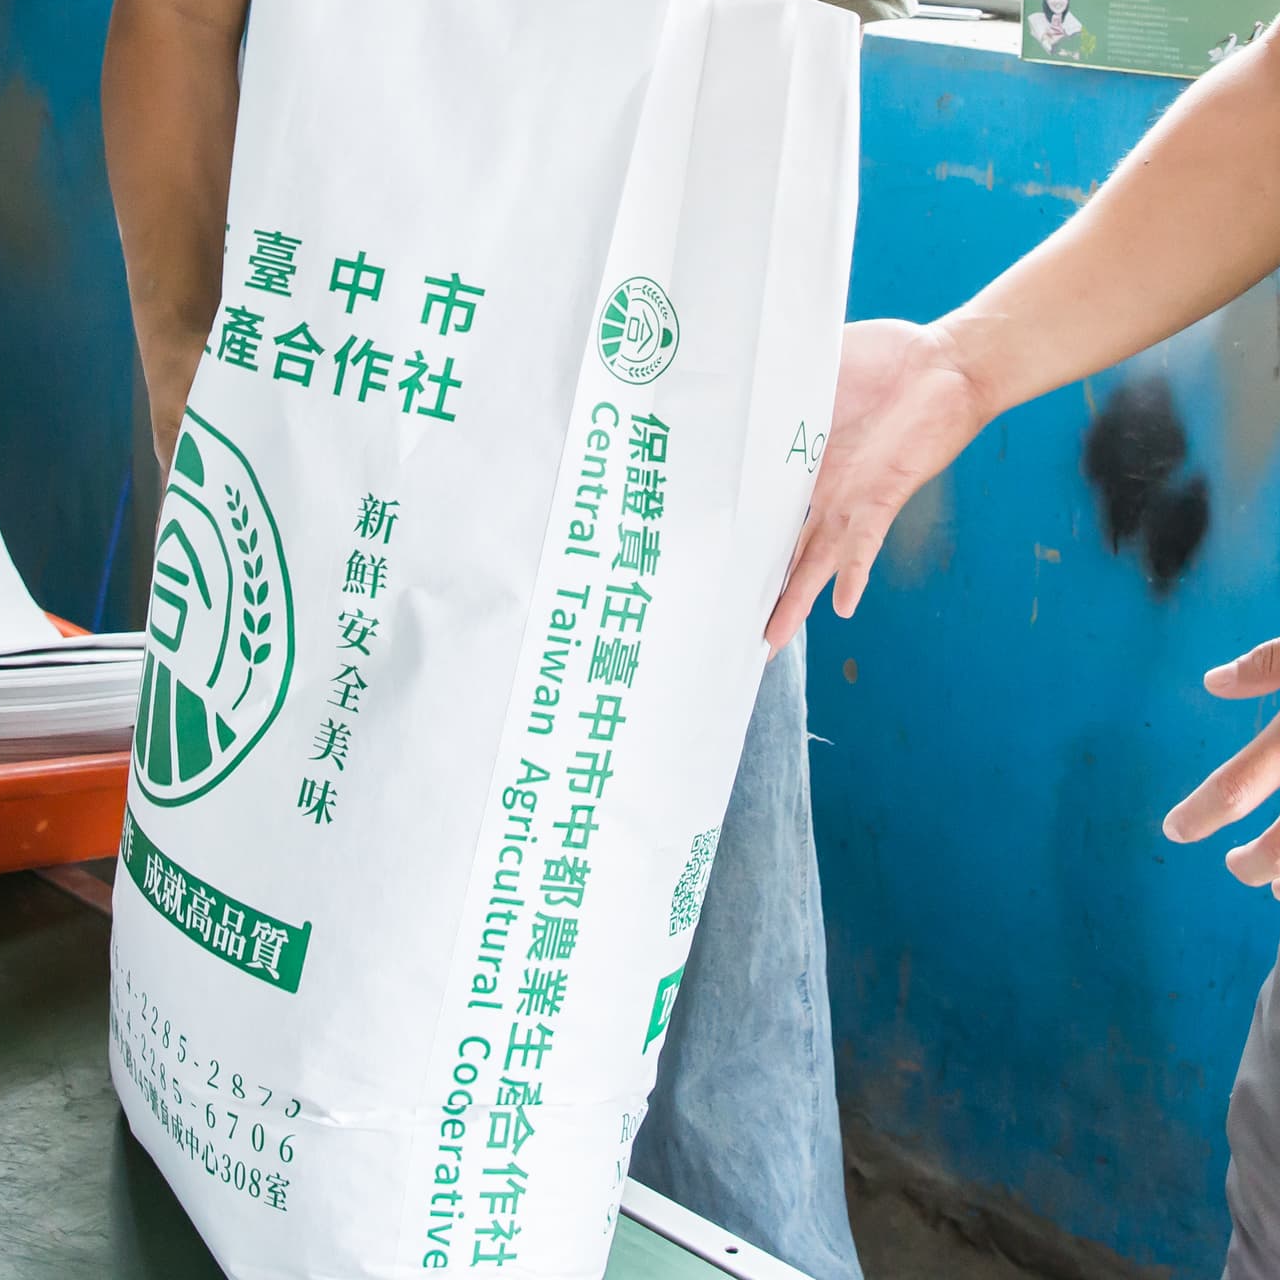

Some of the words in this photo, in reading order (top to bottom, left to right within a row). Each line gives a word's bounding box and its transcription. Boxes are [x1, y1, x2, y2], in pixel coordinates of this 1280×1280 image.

[204, 304, 463, 423] 產合作社
[566, 400, 621, 559] Central
[296, 491, 401, 825] 新鮮安全美味
[527, 584, 592, 735] Taiwan
[142, 852, 290, 982] 成就高品質
[467, 758, 550, 1011] Agricultural
